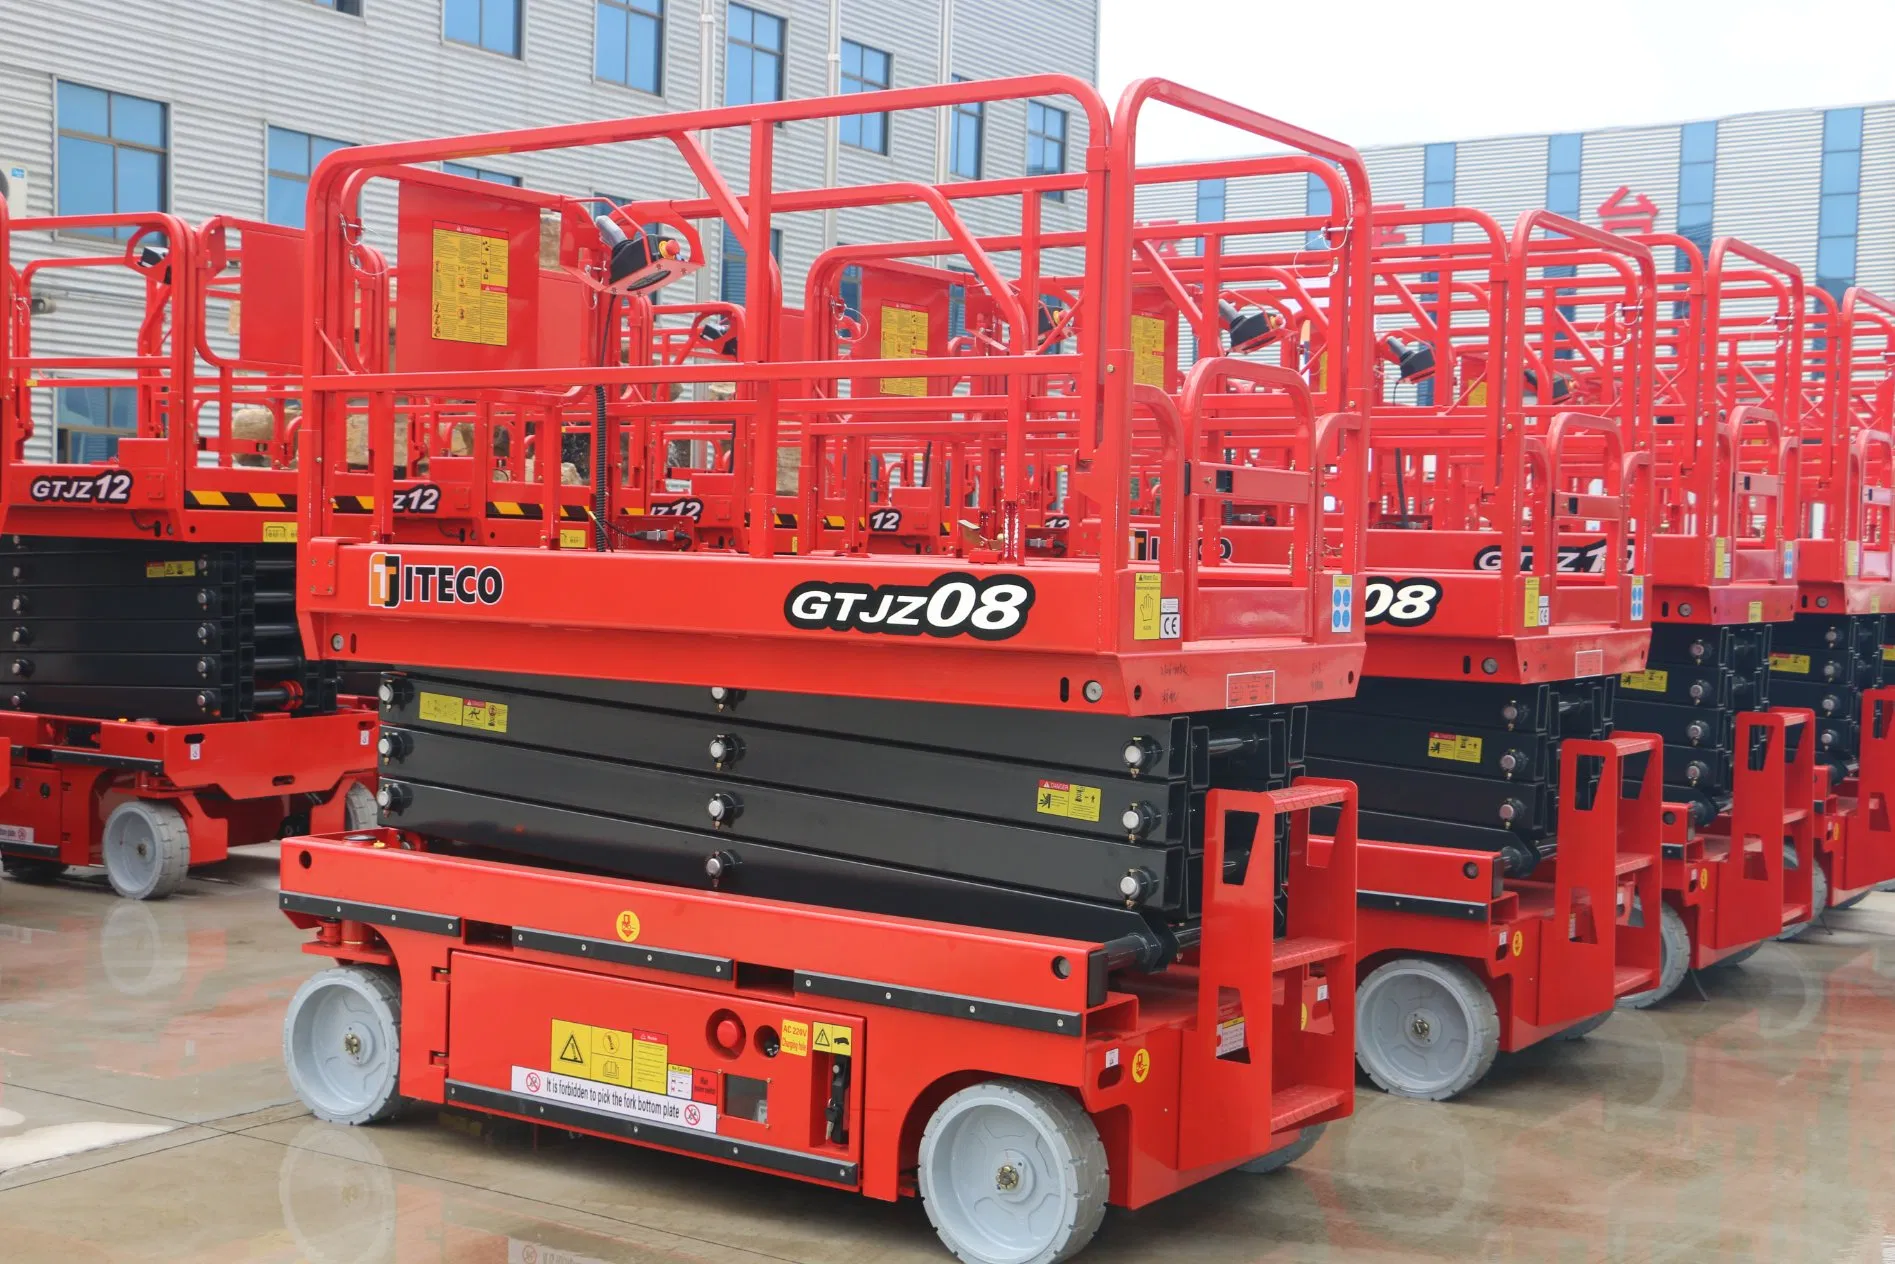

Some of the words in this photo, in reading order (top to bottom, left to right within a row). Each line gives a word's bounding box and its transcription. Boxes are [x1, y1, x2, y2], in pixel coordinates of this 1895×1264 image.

[32, 475, 131, 499] GTJZ12
[872, 512, 900, 530] 12
[791, 581, 1028, 630] GTJZ08
[1050, 782, 1069, 791] DANGER
[783, 1024, 792, 1034] AC
[792, 1026, 808, 1037] 220V
[546, 1076, 552, 1092] It
[552, 1079, 558, 1093] is
[558, 1079, 589, 1099] forbidden
[589, 1088, 597, 1101] to
[597, 1087, 611, 1105] pick
[611, 1091, 623, 1107] the
[623, 1093, 637, 1110] fork
[637, 1095, 662, 1114] bottom
[662, 1100, 680, 1119] plate
